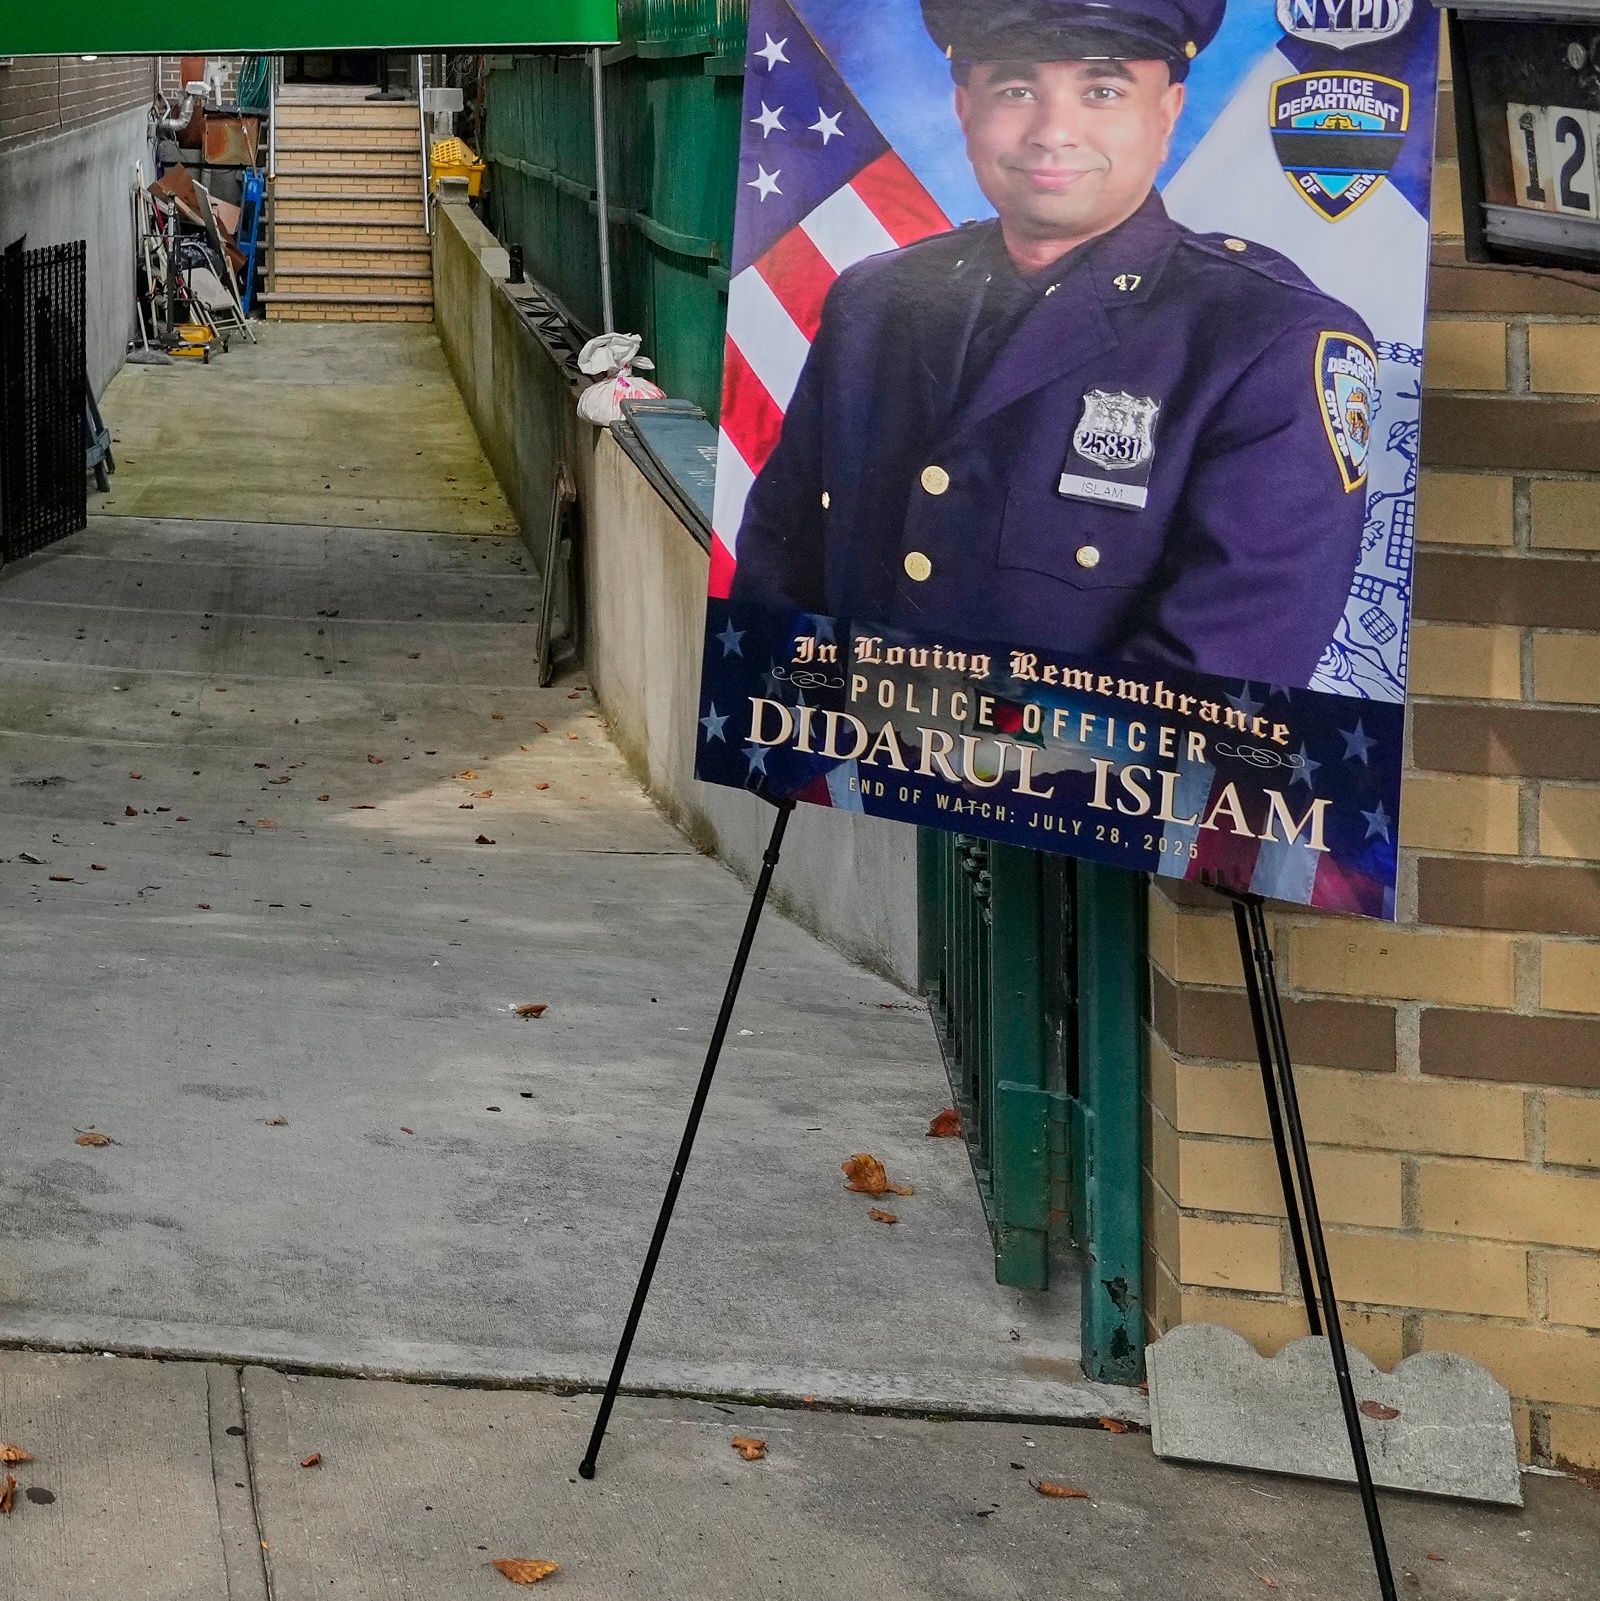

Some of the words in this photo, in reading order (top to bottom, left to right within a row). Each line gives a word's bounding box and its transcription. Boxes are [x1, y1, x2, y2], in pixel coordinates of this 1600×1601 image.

[1278, 93, 1400, 122] DEPARTMENT
[1305, 78, 1374, 97] POLICE
[1299, 174, 1321, 196] OF
[1519, 111, 1600, 212] 12
[1113, 274, 1142, 292] 47
[1080, 429, 1143, 461] 25831
[1324, 389, 1342, 434] CITY
[1336, 432, 1350, 457] OF
[1081, 481, 1124, 500] ISLAM
[791, 635, 838, 665] In
[853, 635, 992, 681] Loving
[1009, 649, 1291, 747] Remembrance
[850, 673, 996, 728] POLICE
[1021, 702, 1208, 765] OFFICER
[743, 695, 1056, 799] DIDARUL
[1086, 756, 1334, 853] ISLAM
[848, 776, 885, 798] END
[899, 786, 923, 805] OF
[936, 793, 1016, 824] WATCH:
[1027, 811, 1083, 836] JULY
[1095, 824, 1130, 849] 28,
[1143, 833, 1199, 860] 2025
